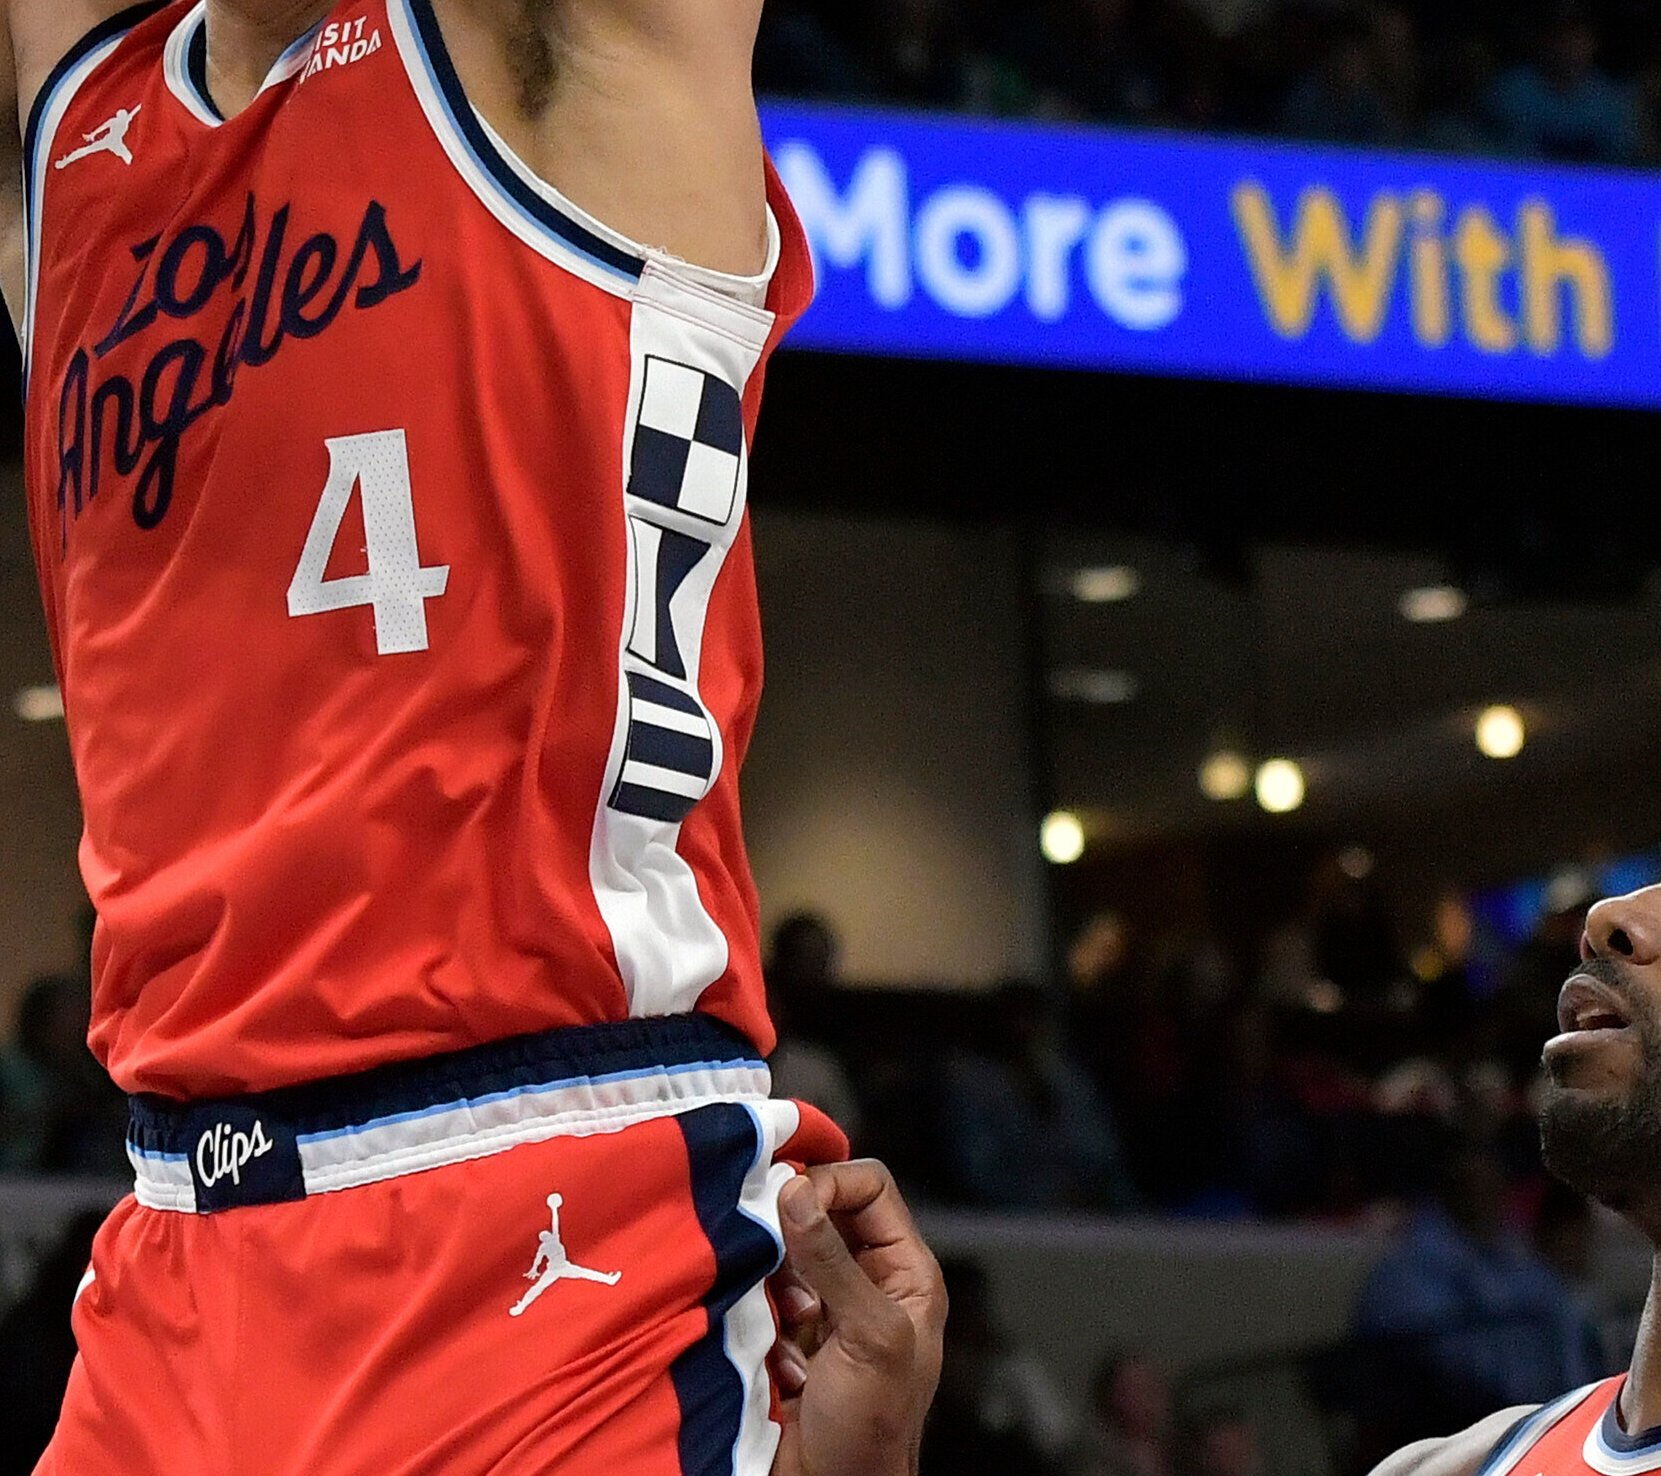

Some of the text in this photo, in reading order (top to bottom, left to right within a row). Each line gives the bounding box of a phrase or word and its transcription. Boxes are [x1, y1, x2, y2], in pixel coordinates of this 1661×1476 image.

[299, 29, 382, 84] ANDA
[314, 15, 367, 51] ISIT
[779, 137, 1187, 331] More
[1230, 177, 1616, 362] With
[287, 427, 451, 656] 4
[196, 1119, 274, 1188] Clips
